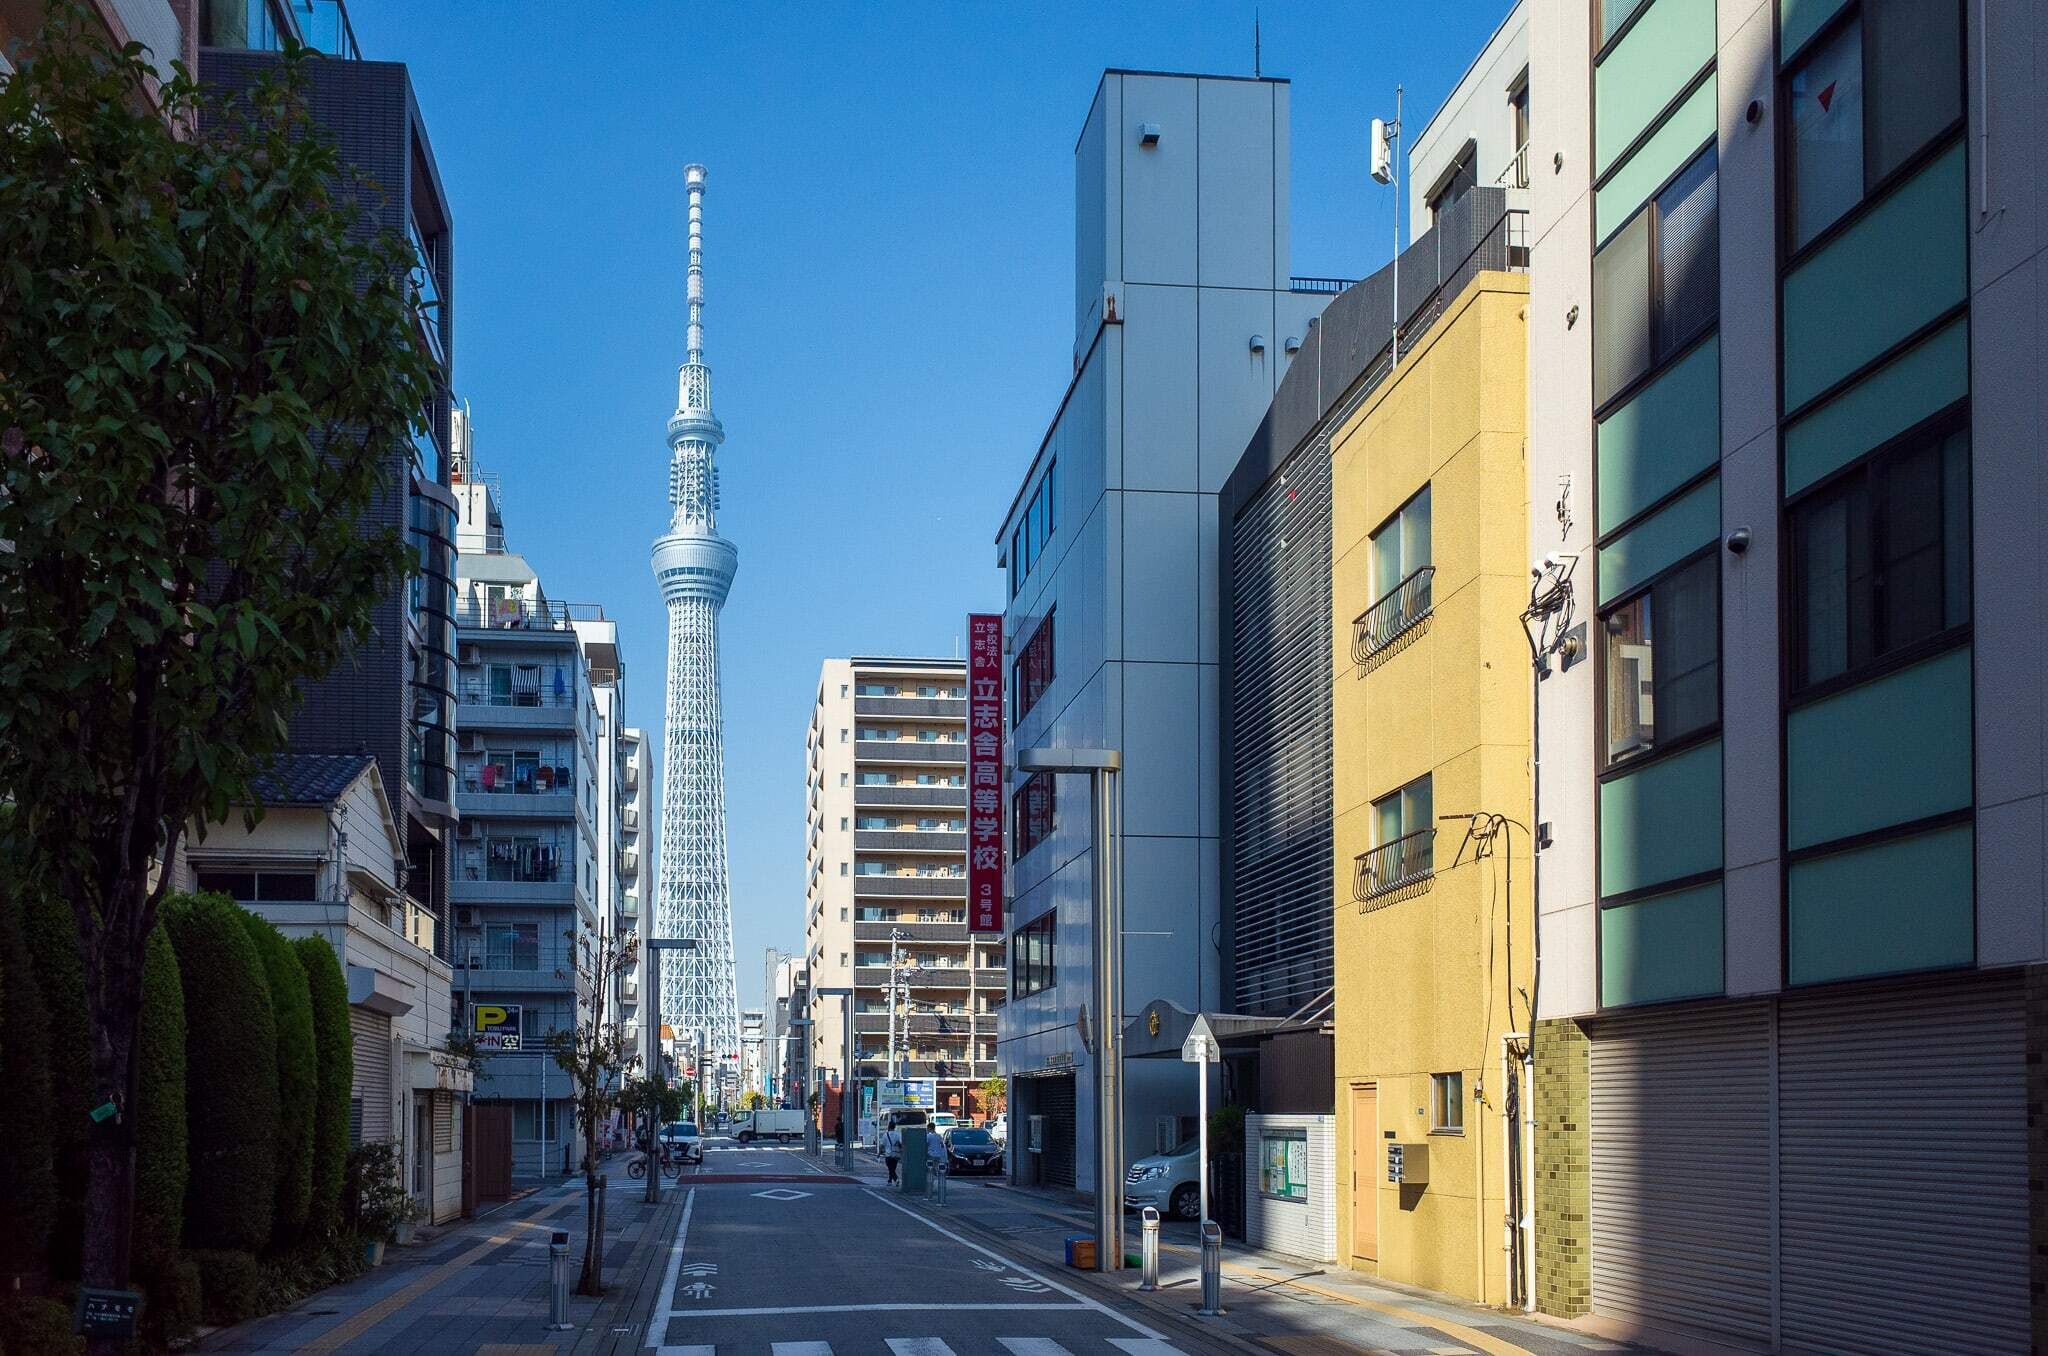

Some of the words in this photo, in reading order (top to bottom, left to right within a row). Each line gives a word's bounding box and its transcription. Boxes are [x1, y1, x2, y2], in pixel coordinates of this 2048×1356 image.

[986, 622, 998, 668] 学校法人
[979, 883, 993, 927] 3号館
[476, 1006, 507, 1031] P
[487, 1036, 500, 1046] IN
[501, 1034, 519, 1050] 空
